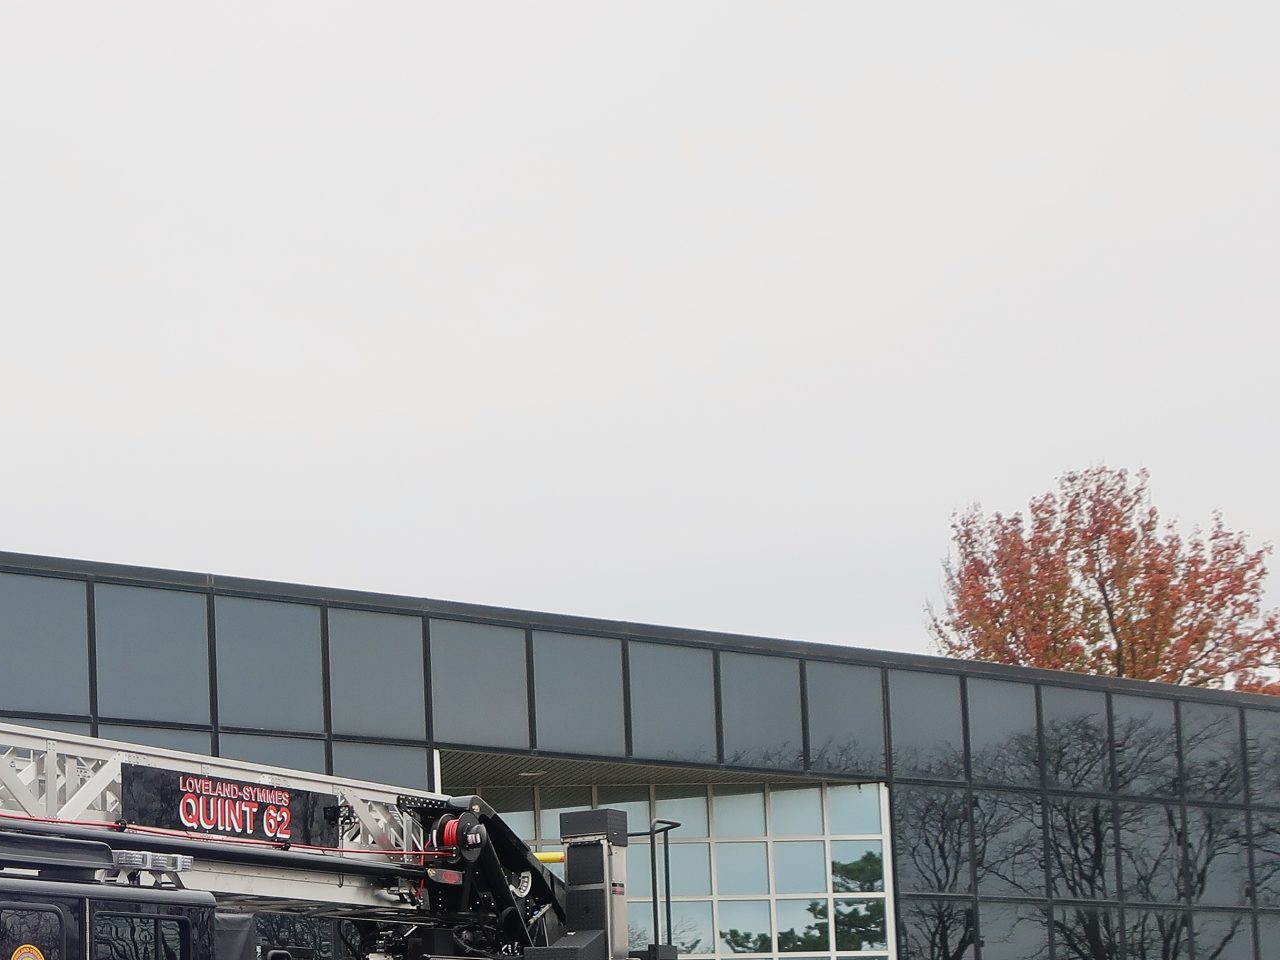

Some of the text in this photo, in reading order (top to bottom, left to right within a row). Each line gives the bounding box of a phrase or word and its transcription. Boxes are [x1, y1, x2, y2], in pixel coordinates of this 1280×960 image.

[179, 776, 290, 807] LOVELAND-SYMMES
[179, 793, 291, 839] QUINT 62
